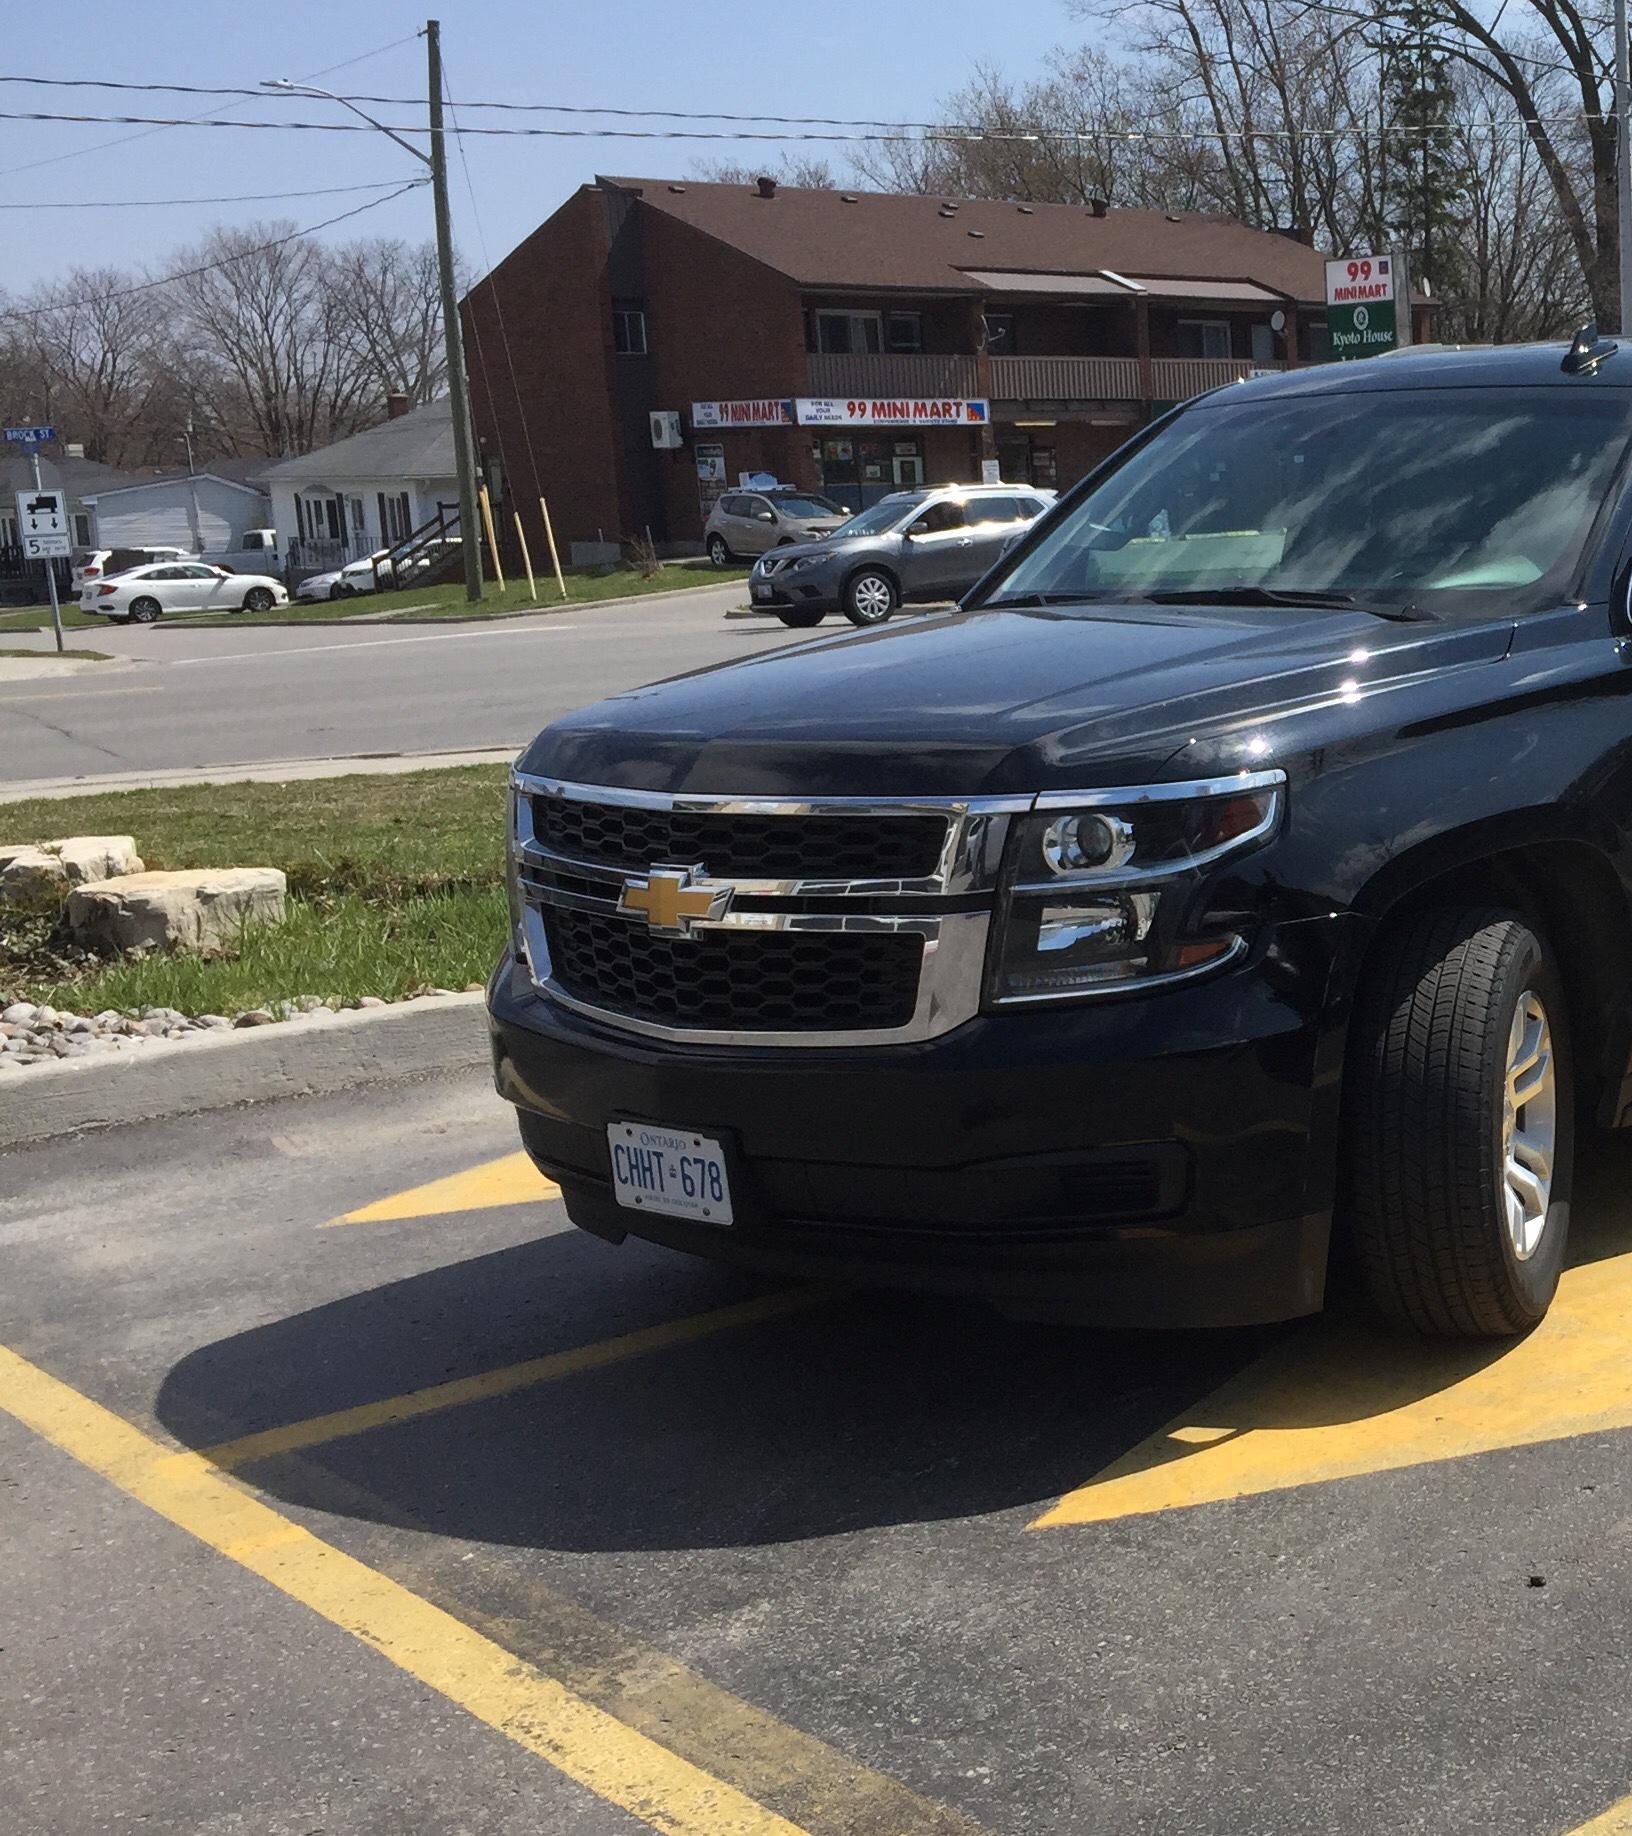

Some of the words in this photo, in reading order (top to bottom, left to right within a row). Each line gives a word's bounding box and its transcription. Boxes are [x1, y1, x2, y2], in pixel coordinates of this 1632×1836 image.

[1346, 260, 1372, 282] 99
[1334, 287, 1357, 301] MINI
[1358, 283, 1388, 300] MART
[1332, 331, 1361, 351] Kyoto
[1363, 330, 1393, 344] House
[752, 401, 780, 422] MART
[846, 400, 867, 418] 99
[871, 400, 910, 419] MINI
[913, 401, 963, 419] MART
[29, 539, 41, 555] 5
[613, 1143, 665, 1193] CHHT
[679, 1155, 724, 1202] 678
